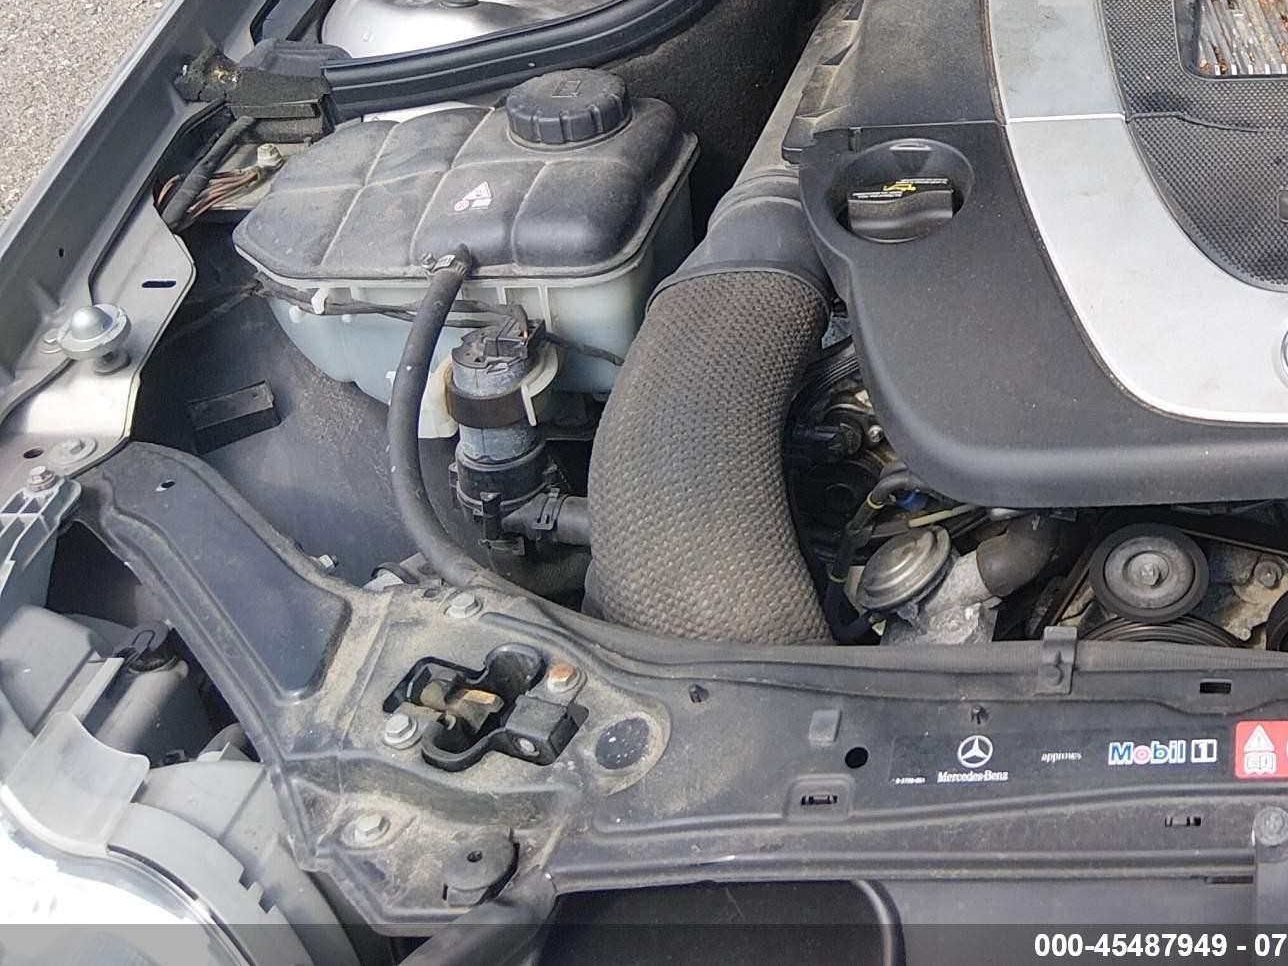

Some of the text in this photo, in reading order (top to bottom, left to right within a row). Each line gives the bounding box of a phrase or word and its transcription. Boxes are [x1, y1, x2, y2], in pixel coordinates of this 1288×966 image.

[1107, 738, 1218, 766] Mobil 1
[936, 769, 1009, 784] Mercedes-Benz
